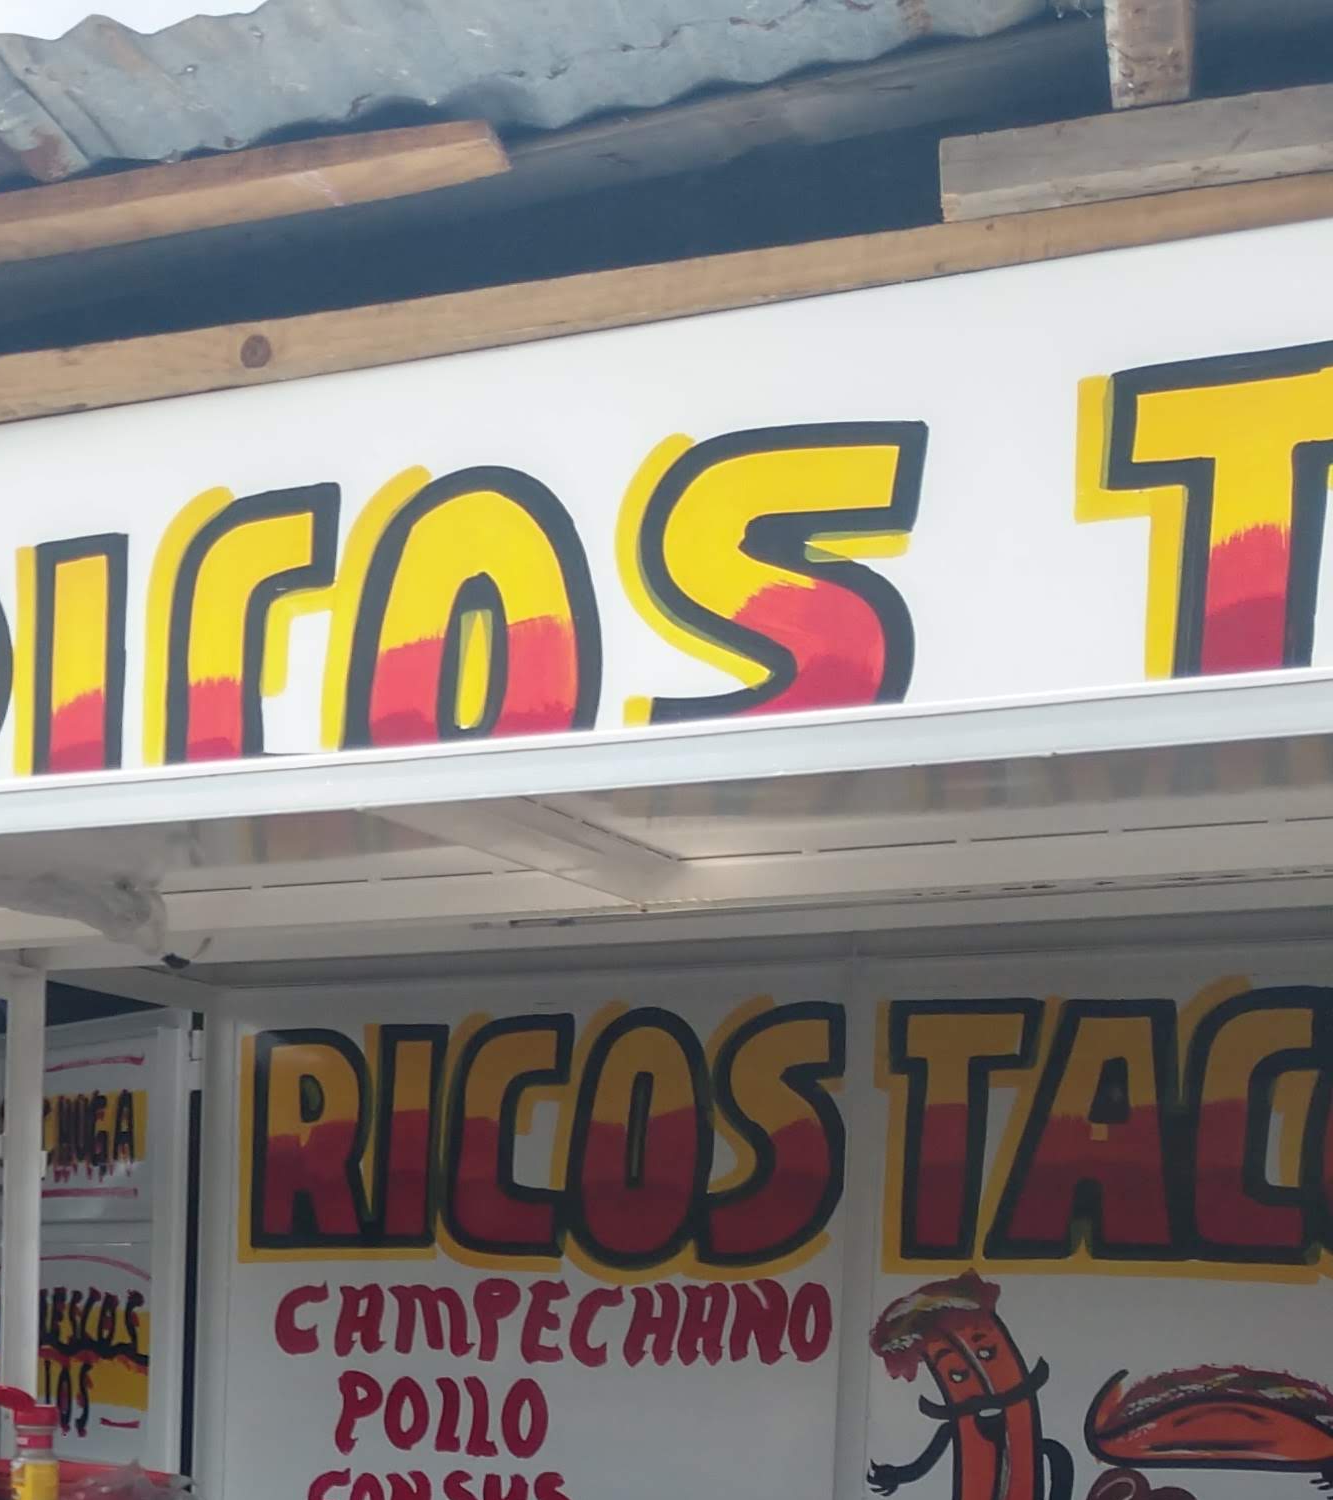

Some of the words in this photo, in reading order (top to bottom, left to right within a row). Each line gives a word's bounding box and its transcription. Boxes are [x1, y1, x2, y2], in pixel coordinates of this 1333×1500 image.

[239, 998, 845, 1282] RICOS
[874, 976, 1333, 1284] TAC
[274, 1278, 833, 1367] CAMPECHANO
[334, 1370, 548, 1458] POLLO
